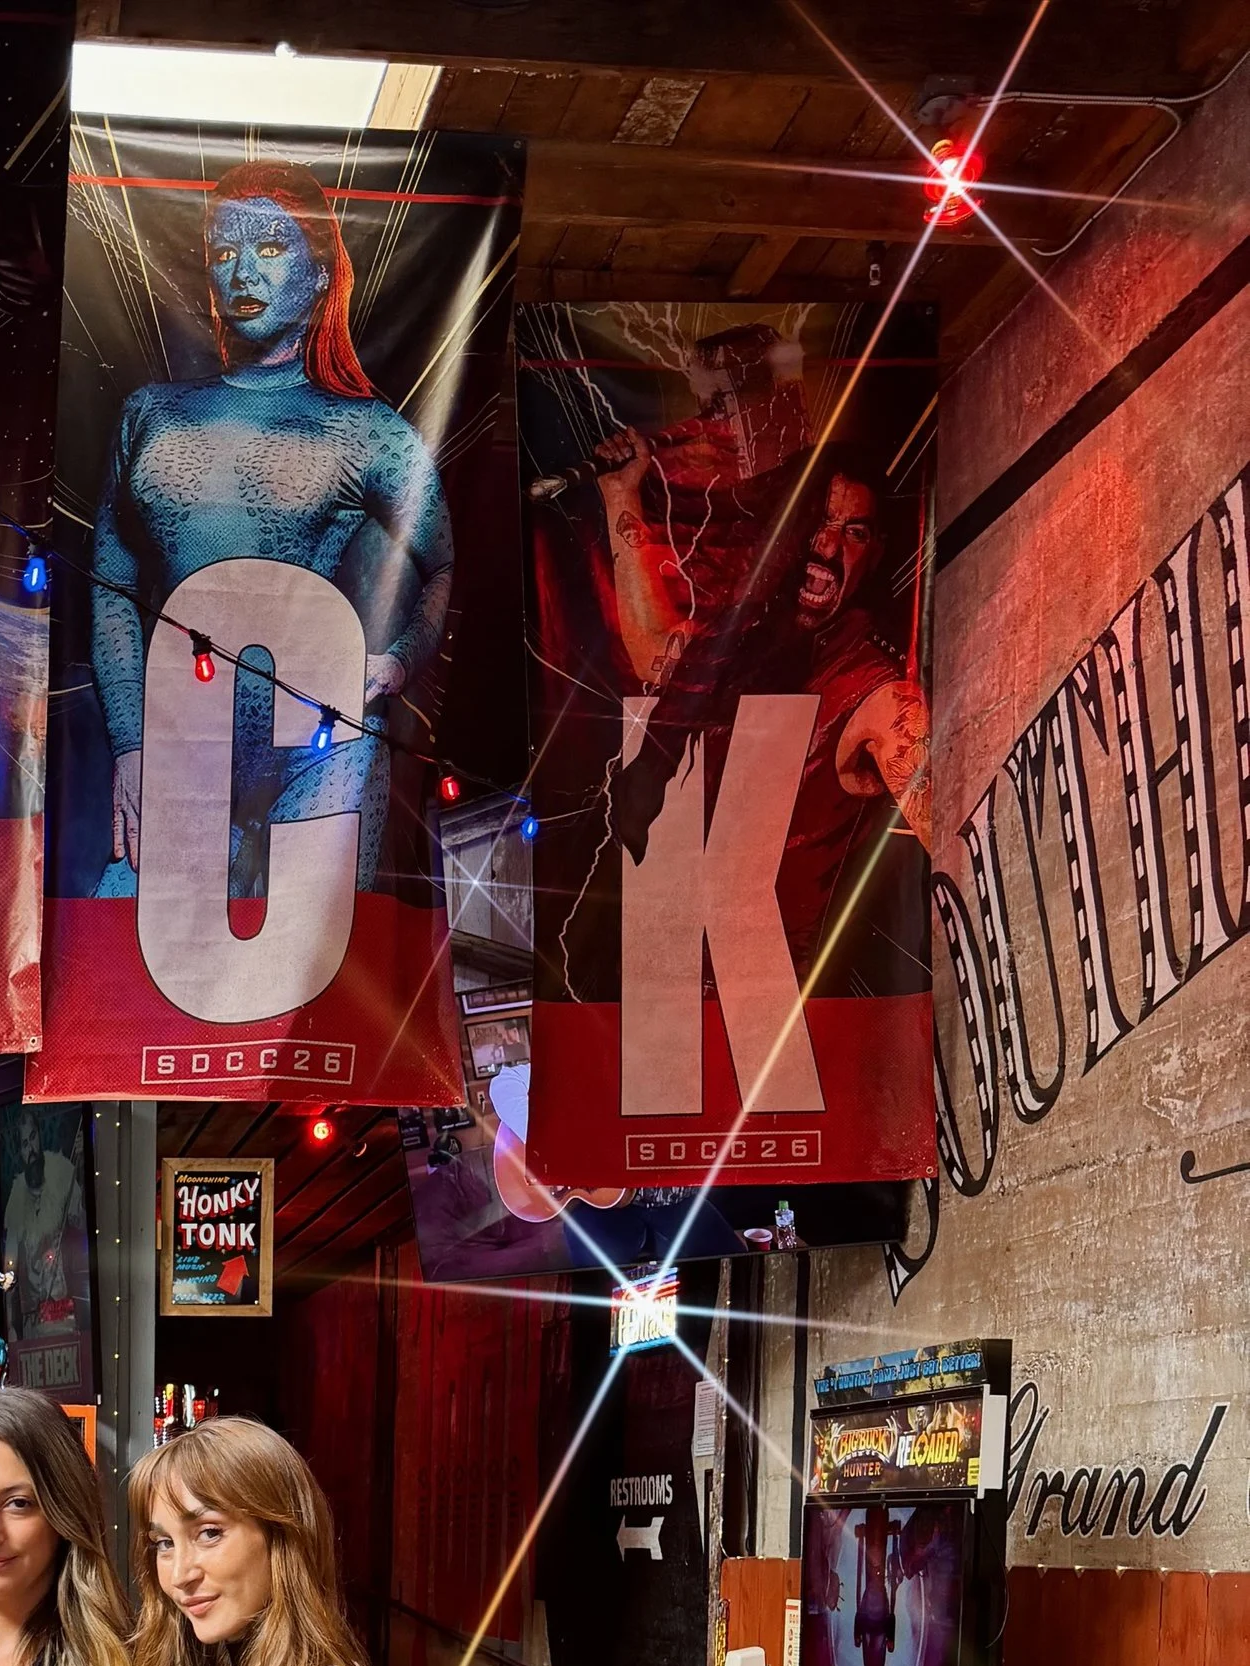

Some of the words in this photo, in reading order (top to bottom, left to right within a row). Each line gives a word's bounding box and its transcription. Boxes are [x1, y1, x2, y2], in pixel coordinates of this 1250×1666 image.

[136, 556, 366, 1025] C
[177, 1177, 260, 1221] HONKY
[178, 1222, 256, 1250] TONK
[843, 1462, 881, 1478] HUNTER
[610, 1474, 673, 1507] RESTROOMS
